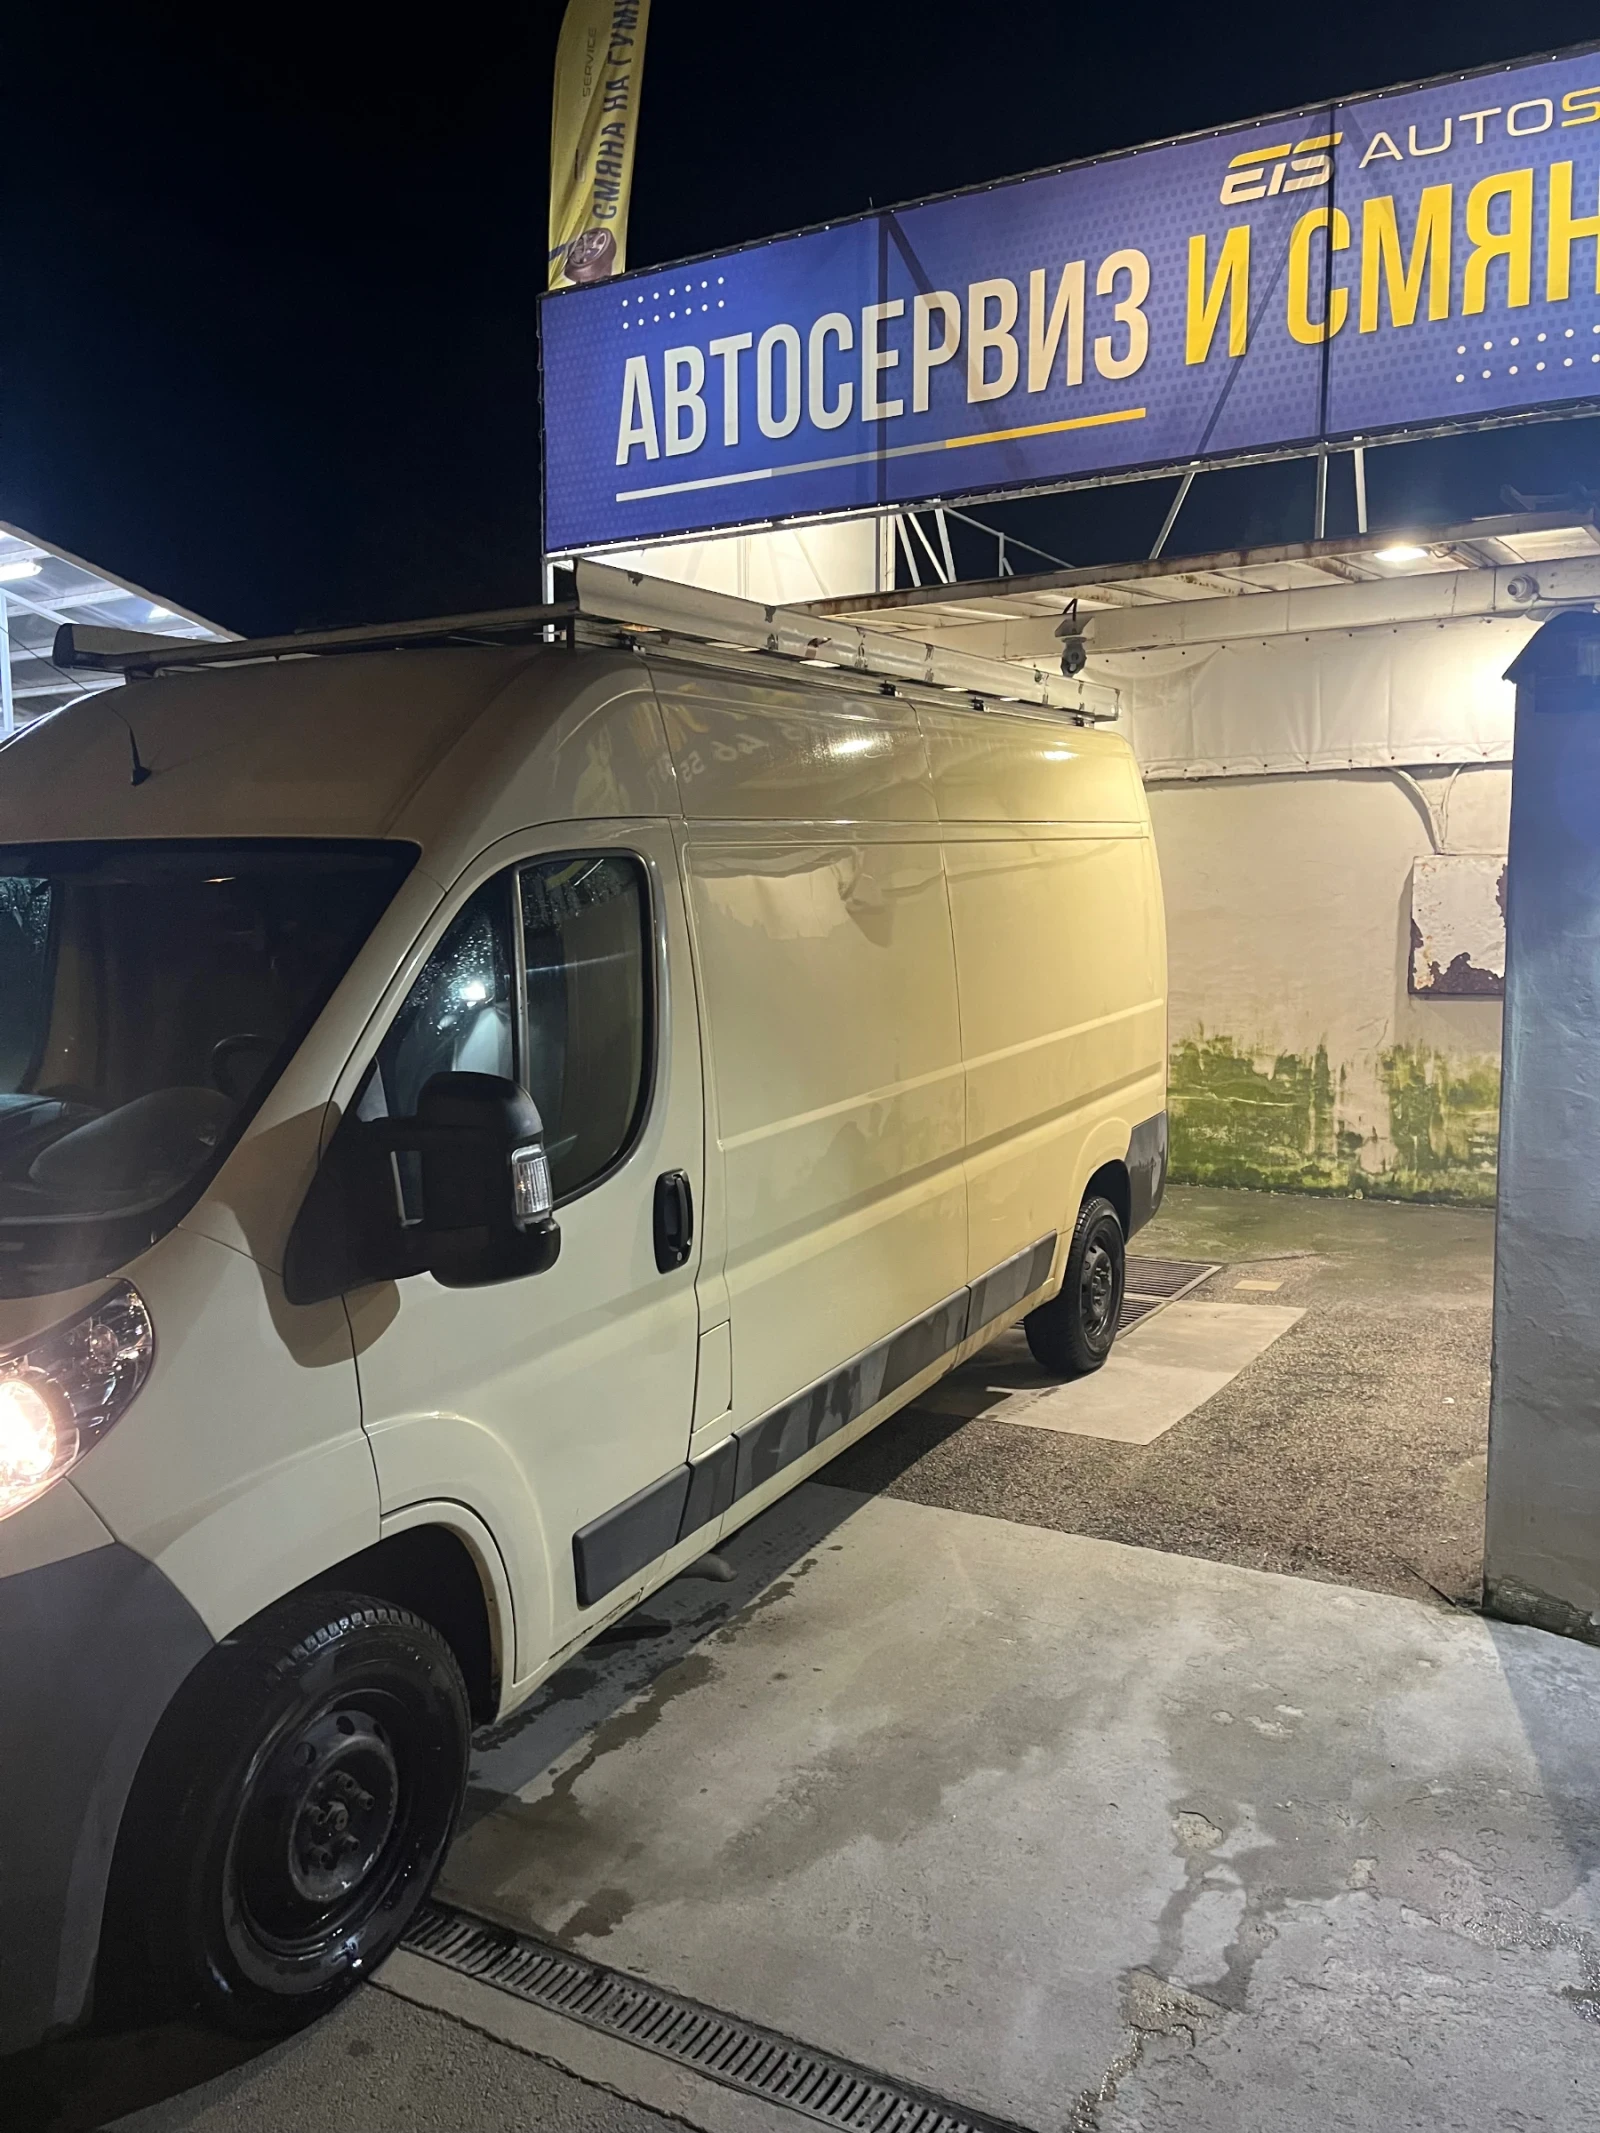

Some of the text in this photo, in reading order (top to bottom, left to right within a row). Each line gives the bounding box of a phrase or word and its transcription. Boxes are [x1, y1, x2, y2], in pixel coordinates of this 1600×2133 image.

[583, 26, 597, 97] SERVICE
[602, 74, 631, 113] НА
[592, 121, 626, 219] СМЯНА
[1219, 86, 1600, 206] EIS AUTOS
[615, 160, 1600, 466] АВТОСЕРВИЗ И СМЯН
